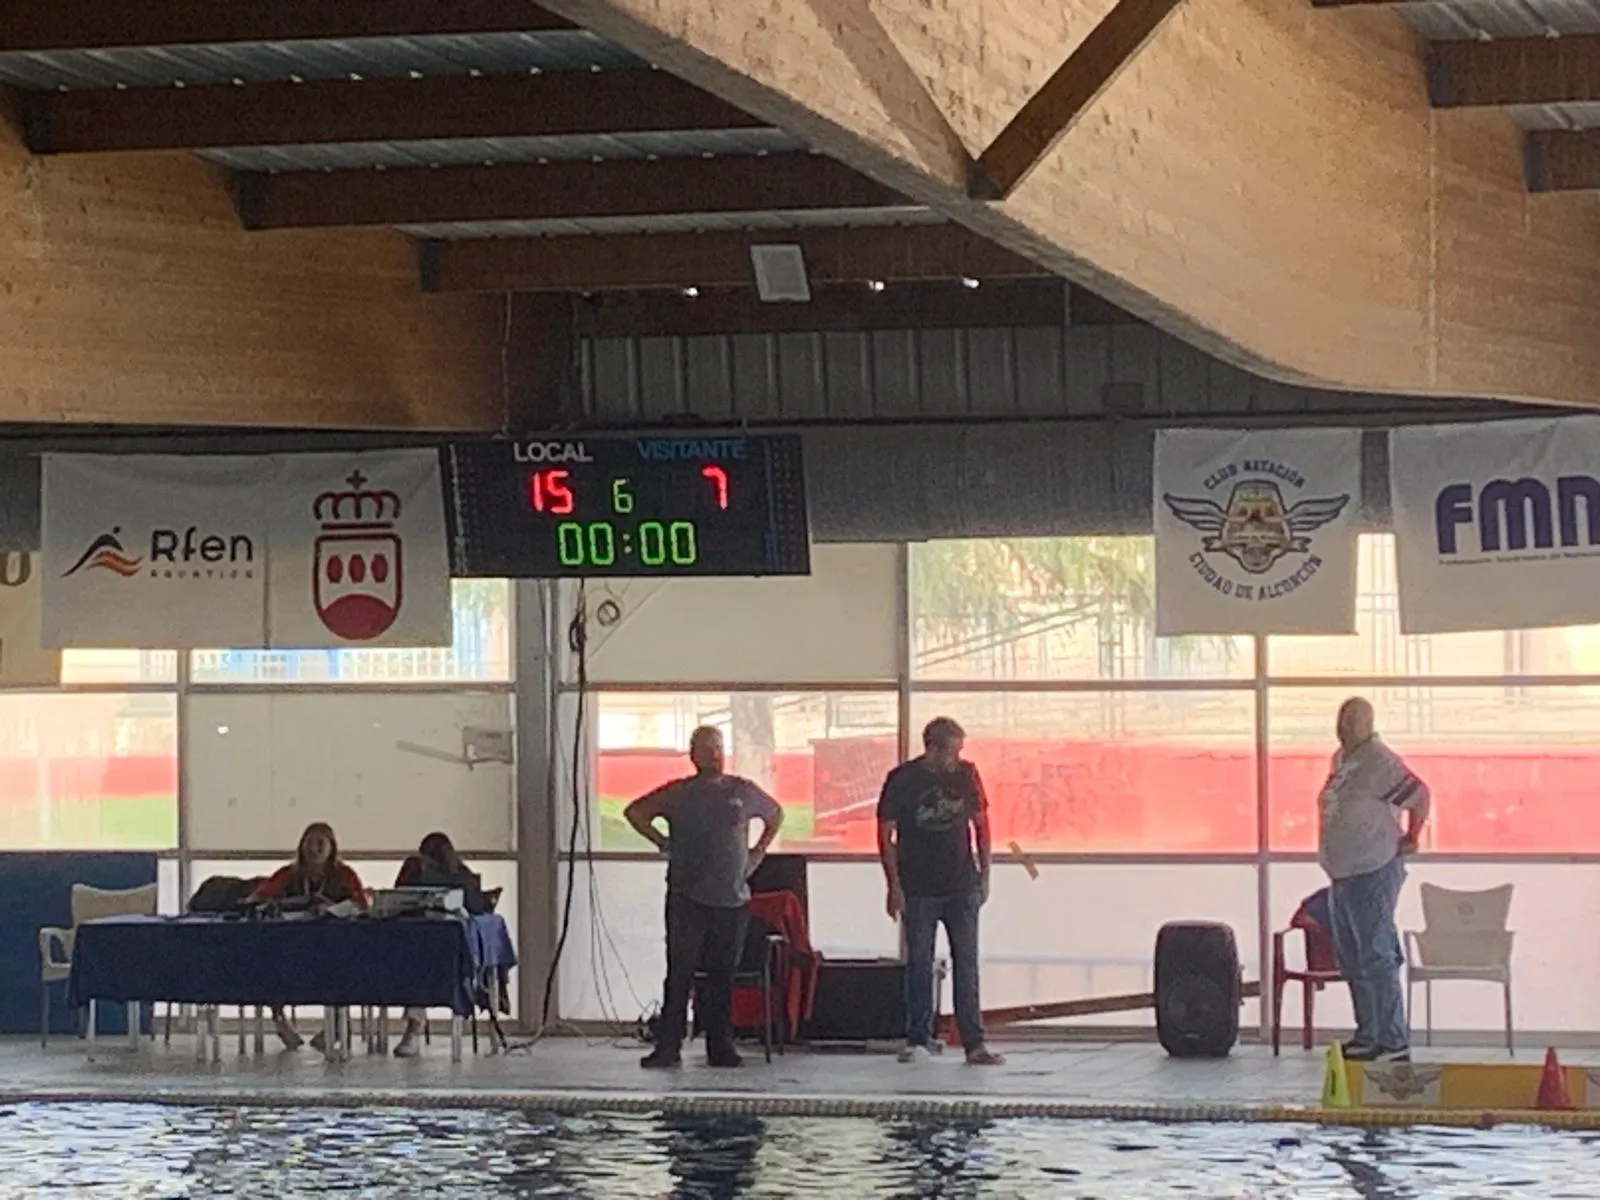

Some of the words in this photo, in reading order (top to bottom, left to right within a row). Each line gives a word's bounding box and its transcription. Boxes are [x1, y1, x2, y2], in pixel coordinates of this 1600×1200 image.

[513, 441, 594, 463] LOCAL
[636, 439, 747, 461] VISITANTE
[530, 469, 574, 514] 15
[612, 478, 634, 514] 6
[702, 464, 730, 511] 7
[150, 525, 254, 562] Rfen
[557, 521, 697, 566] 00:00
[1235, 583, 1254, 601] DE
